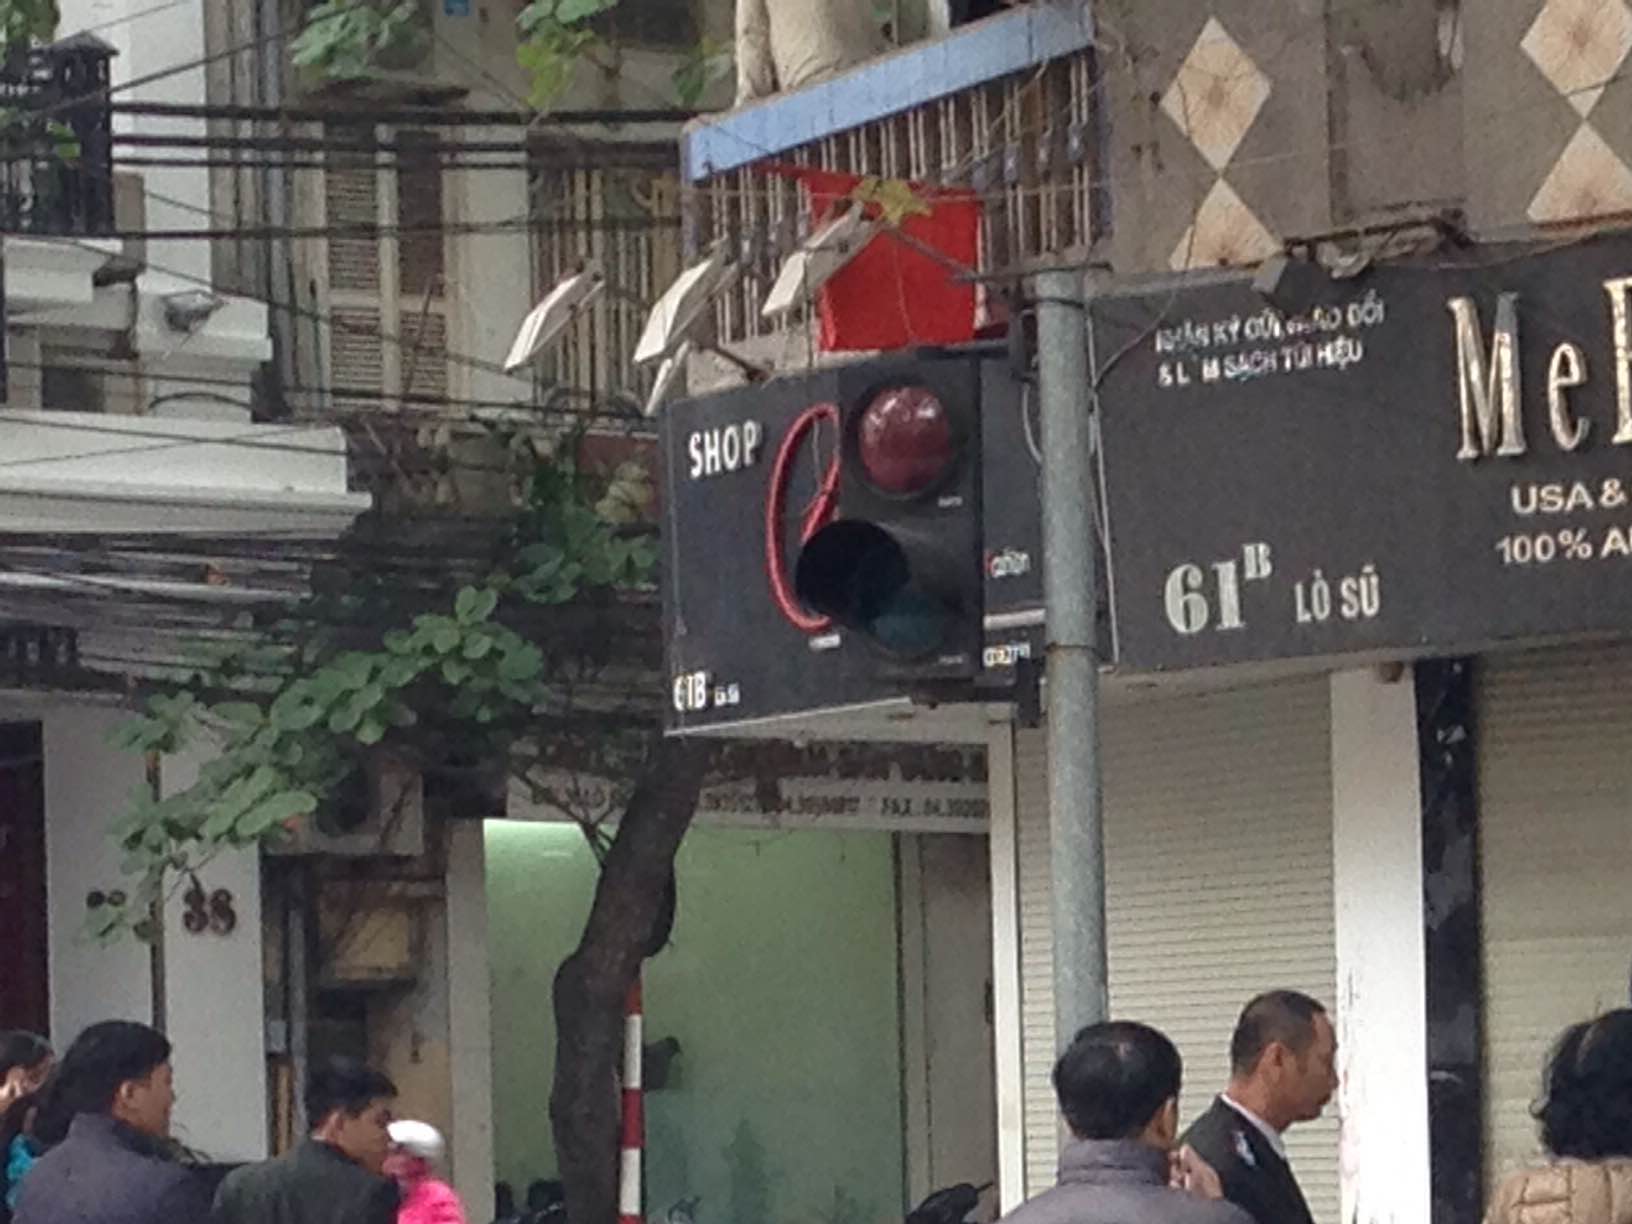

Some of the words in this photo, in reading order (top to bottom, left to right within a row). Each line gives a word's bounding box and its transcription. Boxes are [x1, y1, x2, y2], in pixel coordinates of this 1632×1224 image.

[689, 419, 761, 479] SHOP
[1511, 482, 1594, 515] USA
[1599, 478, 1626, 509] &
[1496, 528, 1593, 564] 100%
[1295, 568, 1332, 623] LÒ
